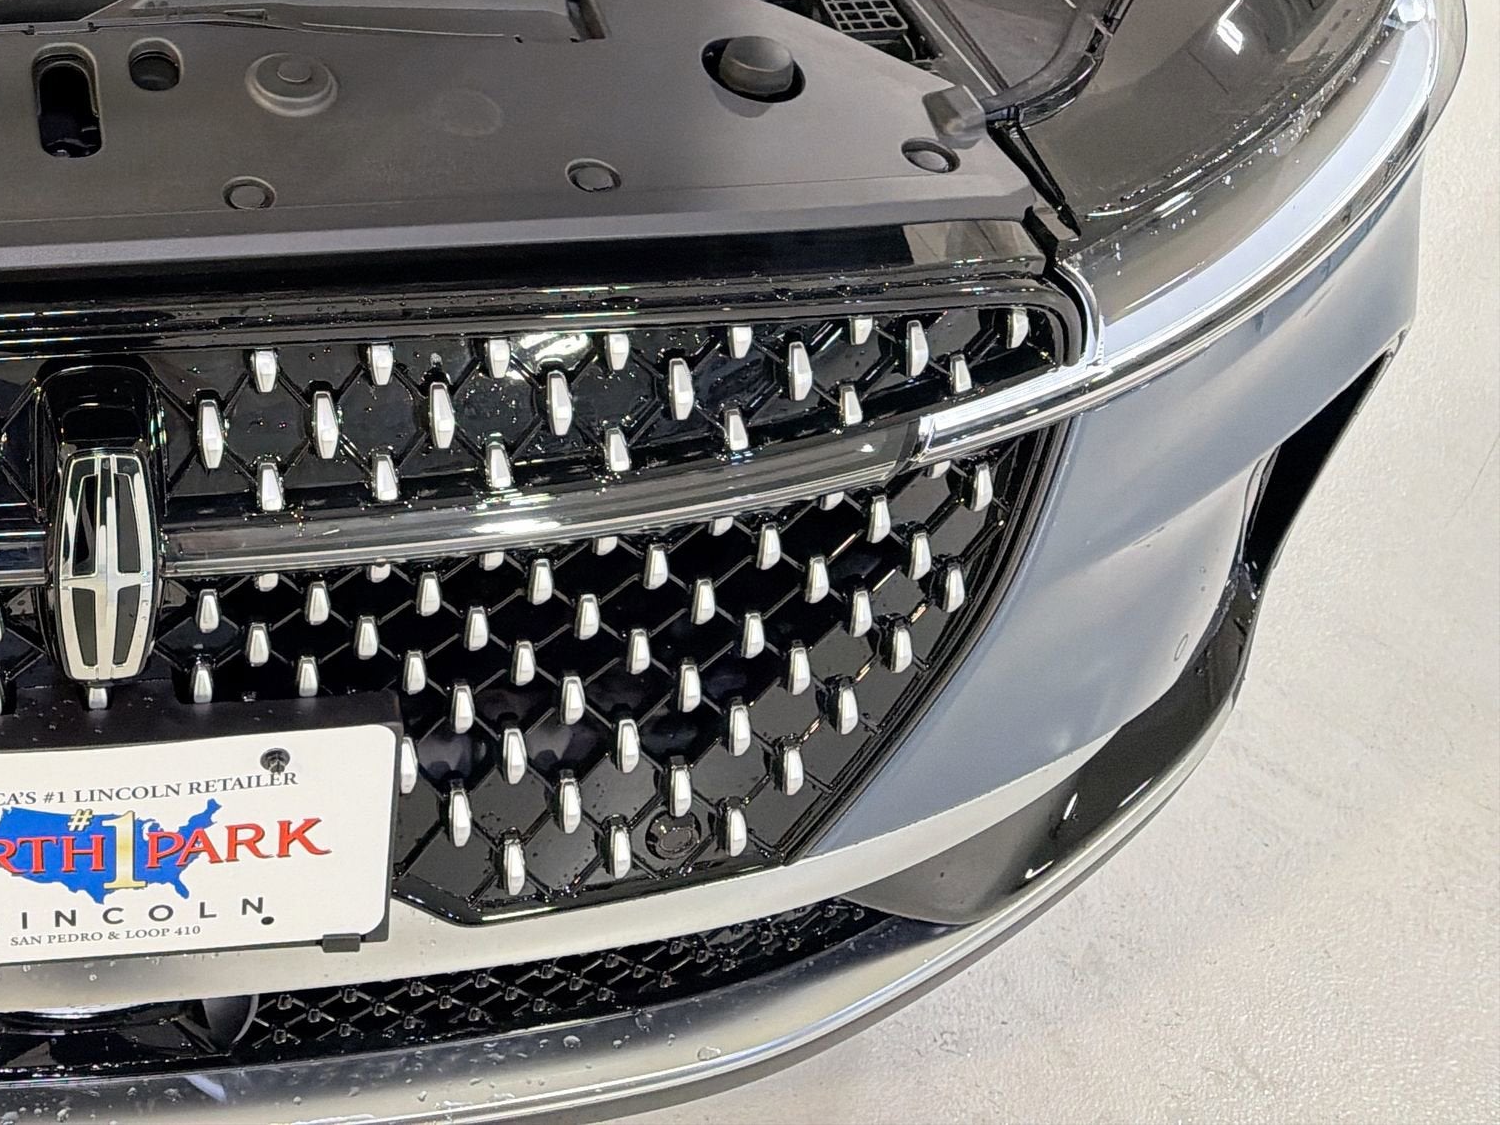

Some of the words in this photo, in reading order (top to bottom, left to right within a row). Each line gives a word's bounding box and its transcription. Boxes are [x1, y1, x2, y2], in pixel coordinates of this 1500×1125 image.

[43, 790, 66, 804] #1
[74, 783, 182, 803] LINCOLN
[188, 771, 298, 795] RETAILER
[146, 818, 332, 868] PARK
[10, 936, 41, 946] SAN
[47, 932, 103, 944] PEDRO
[108, 930, 120, 940] &
[126, 928, 170, 939] LOOP
[174, 925, 200, 936] 410
